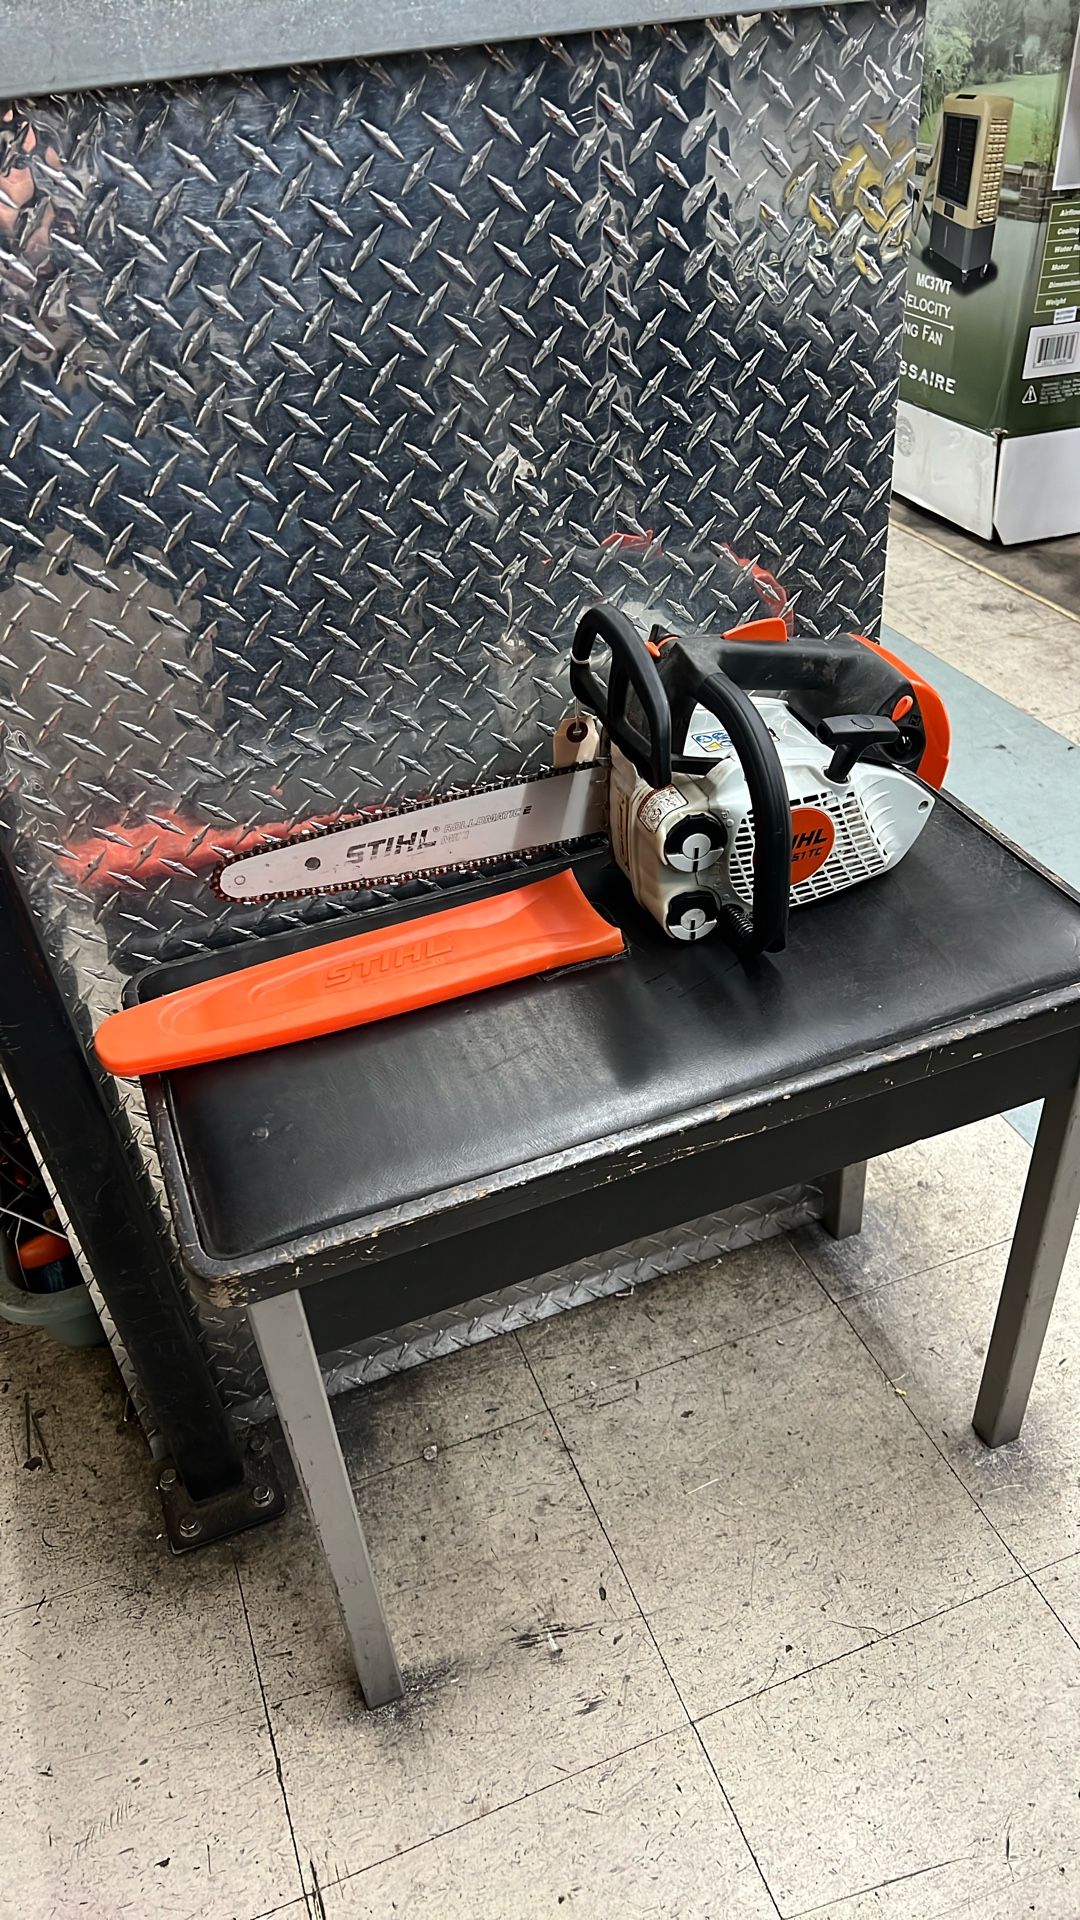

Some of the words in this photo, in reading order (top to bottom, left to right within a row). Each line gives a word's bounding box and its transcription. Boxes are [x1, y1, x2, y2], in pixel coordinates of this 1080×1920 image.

[903, 321, 919, 338] NG
[899, 360, 956, 394] SSAIRE
[346, 829, 437, 864] STIHL
[792, 828, 828, 851] IHL
[792, 851, 807, 862] 51
[324, 938, 454, 989] STIHL
